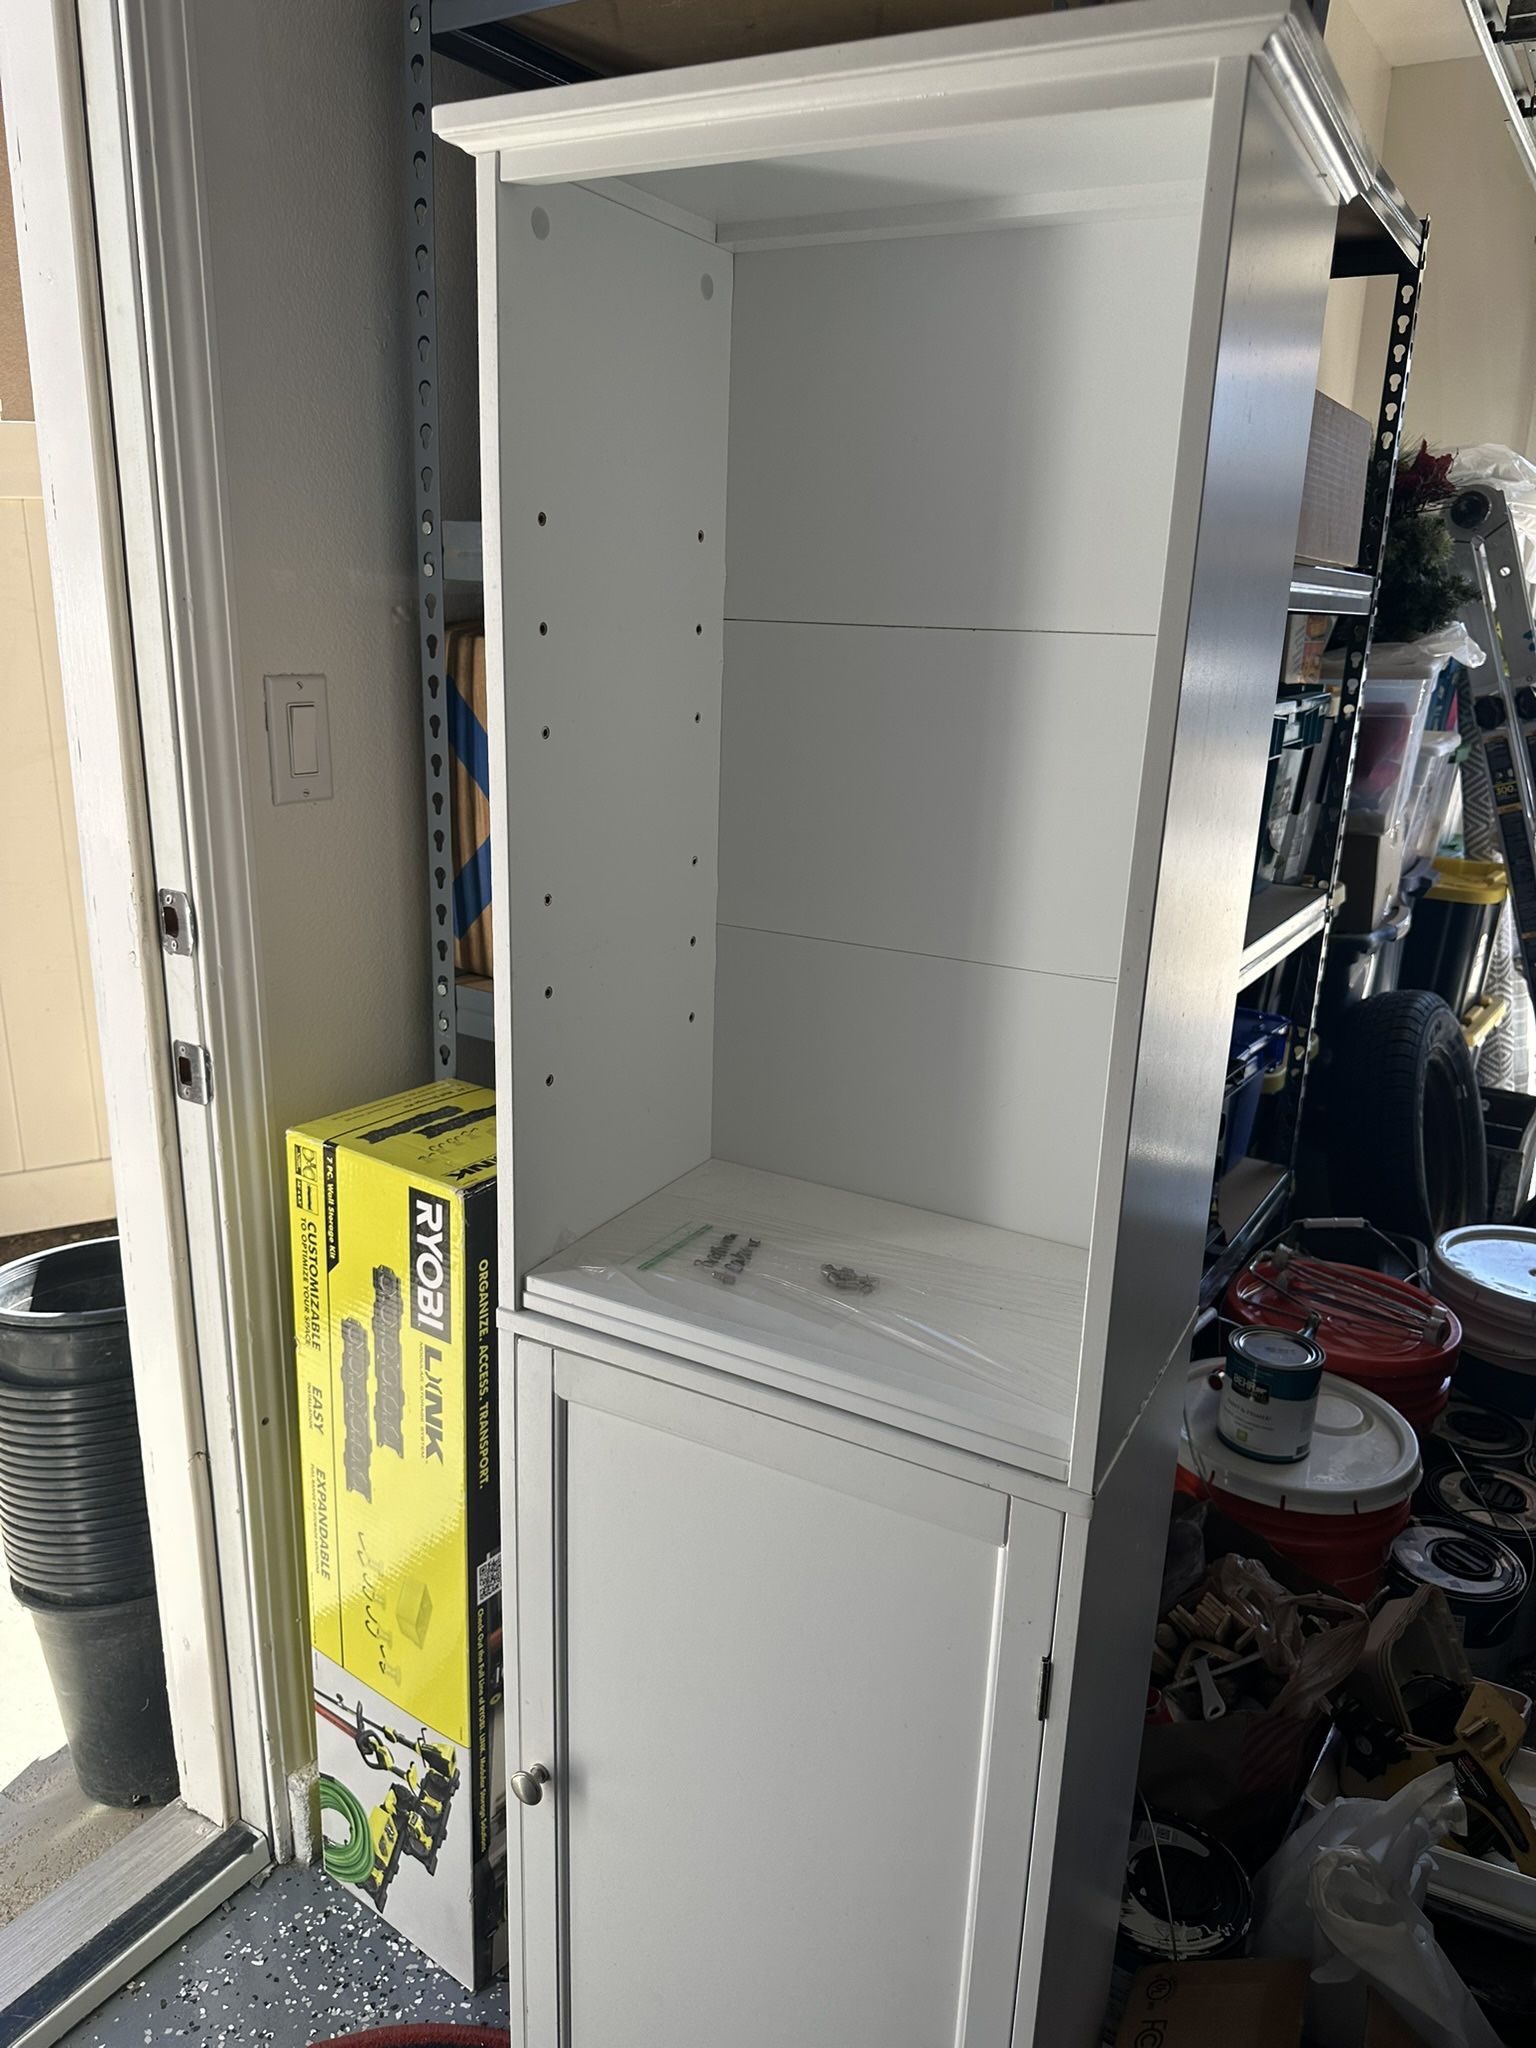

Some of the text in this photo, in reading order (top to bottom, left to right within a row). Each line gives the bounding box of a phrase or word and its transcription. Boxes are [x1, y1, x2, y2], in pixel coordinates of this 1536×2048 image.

[326, 1164, 334, 1181] PC.
[327, 1183, 335, 1205] Wall
[301, 1217, 308, 1231] TO
[327, 1206, 335, 1244] Storage
[301, 1233, 309, 1282] OPTIMIZE
[416, 1199, 444, 1331] RYOBI
[307, 1221, 321, 1351] CUSTOMIZABLE
[478, 1258, 490, 1490] ORGANIZE. ACCESS. TRANSPORT.
[312, 1385, 324, 1436] EASY
[316, 1467, 331, 1580] EXPANDABLE
[477, 1633, 485, 1649] Out
[478, 1696, 485, 1705] of
[479, 1789, 487, 1818] Storage
